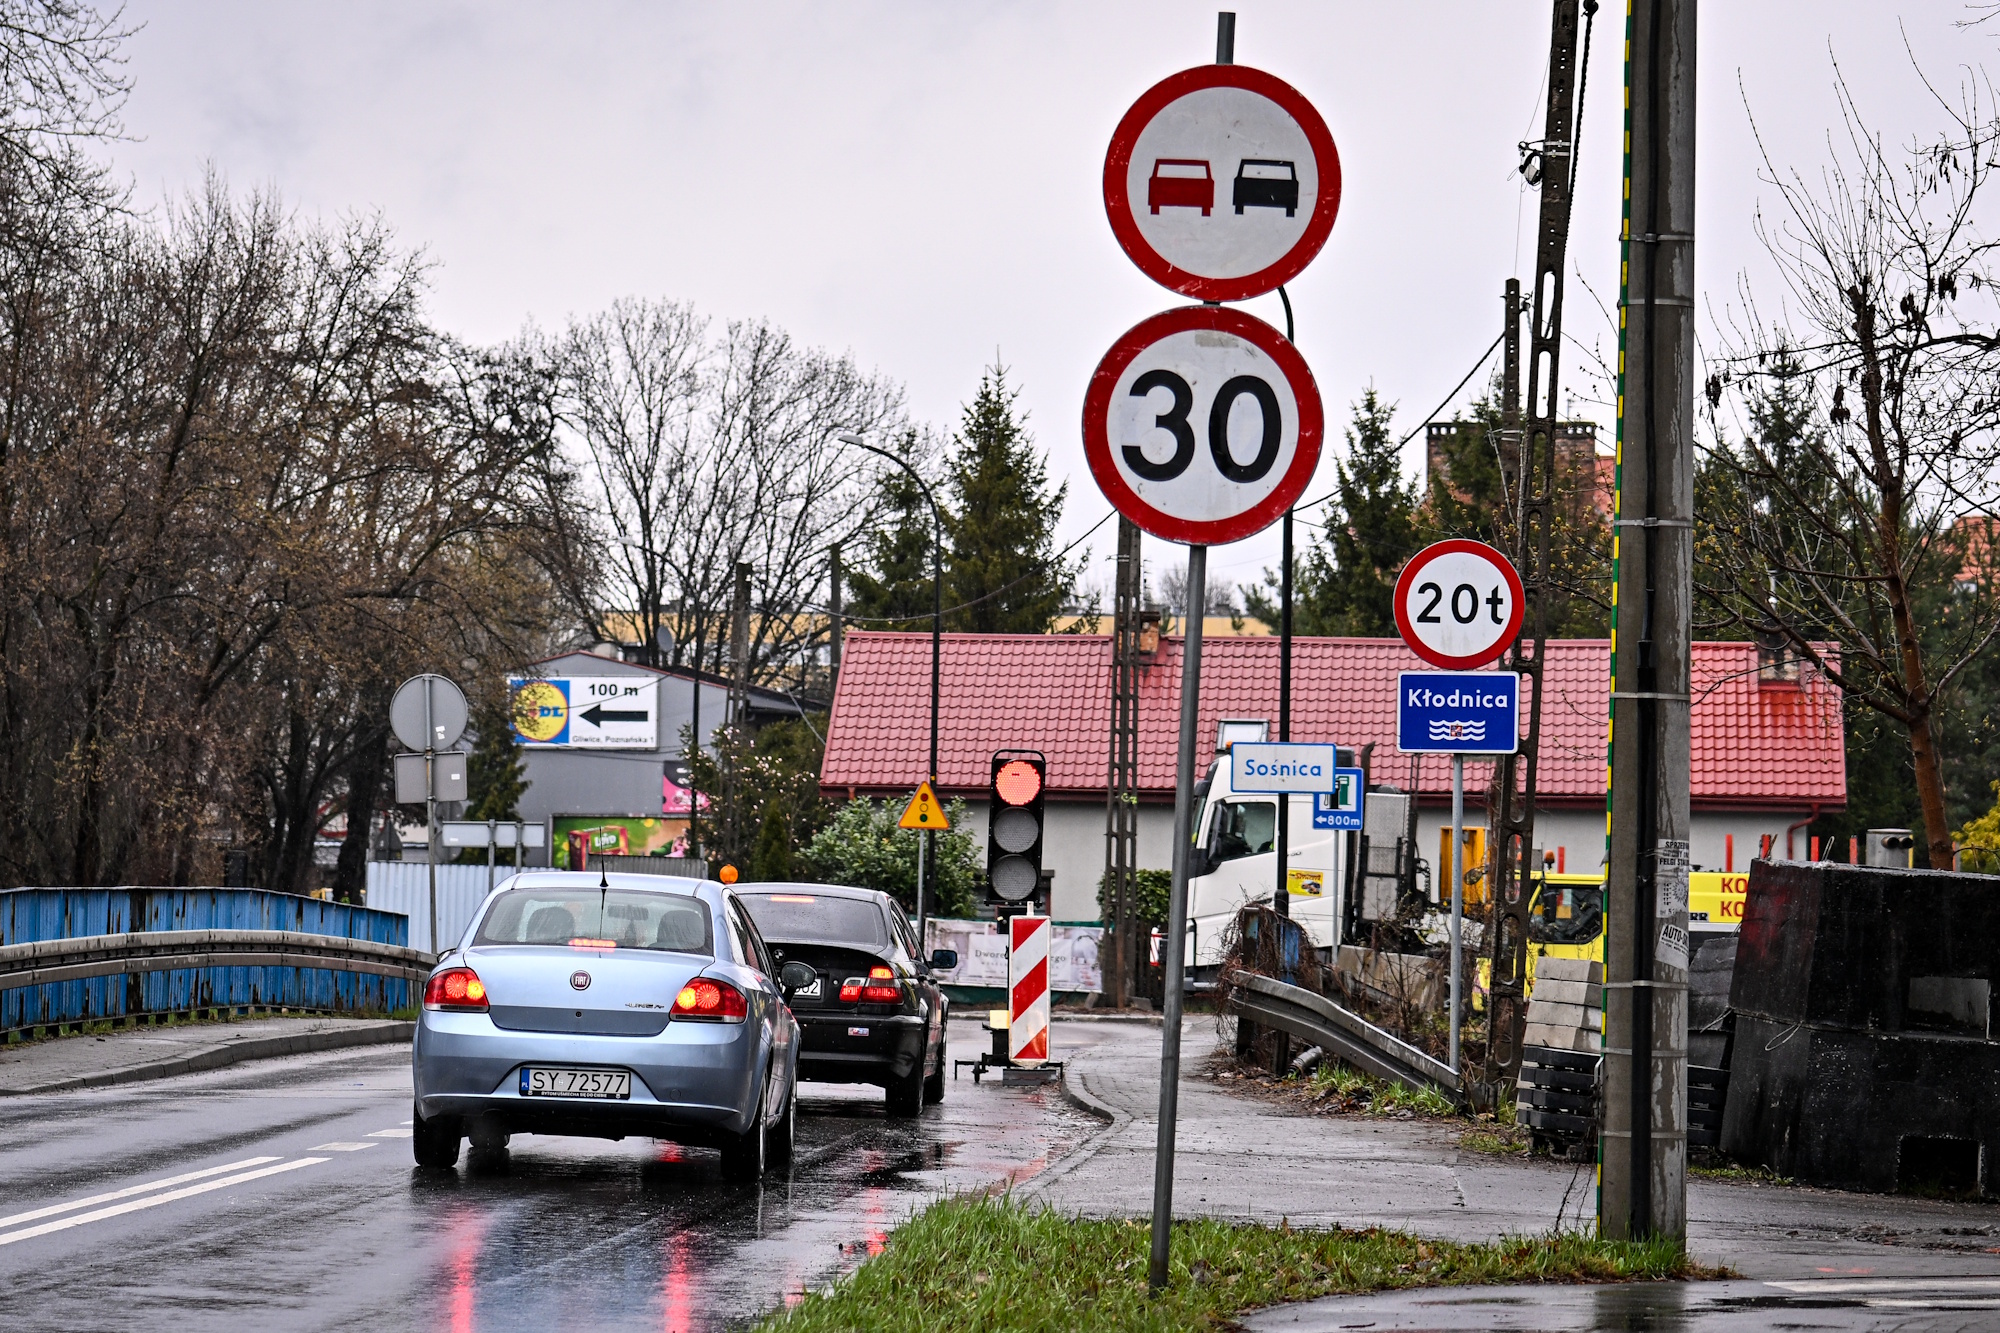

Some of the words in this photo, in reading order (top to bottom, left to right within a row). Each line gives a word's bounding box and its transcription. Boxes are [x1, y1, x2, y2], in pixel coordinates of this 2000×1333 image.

[1121, 369, 1282, 484] 30
[1416, 581, 1504, 625] 20t
[588, 683, 618, 696] 100
[623, 687, 638, 696] m
[1408, 688, 1508, 709] Kłodnica
[1244, 758, 1322, 777] Sośnica
[1327, 814, 1361, 826] 800m
[1659, 857, 1676, 866] FELGI
[574, 975, 587, 986] FIAT
[533, 1072, 559, 1090] SY
[567, 1072, 626, 1093] 72577
